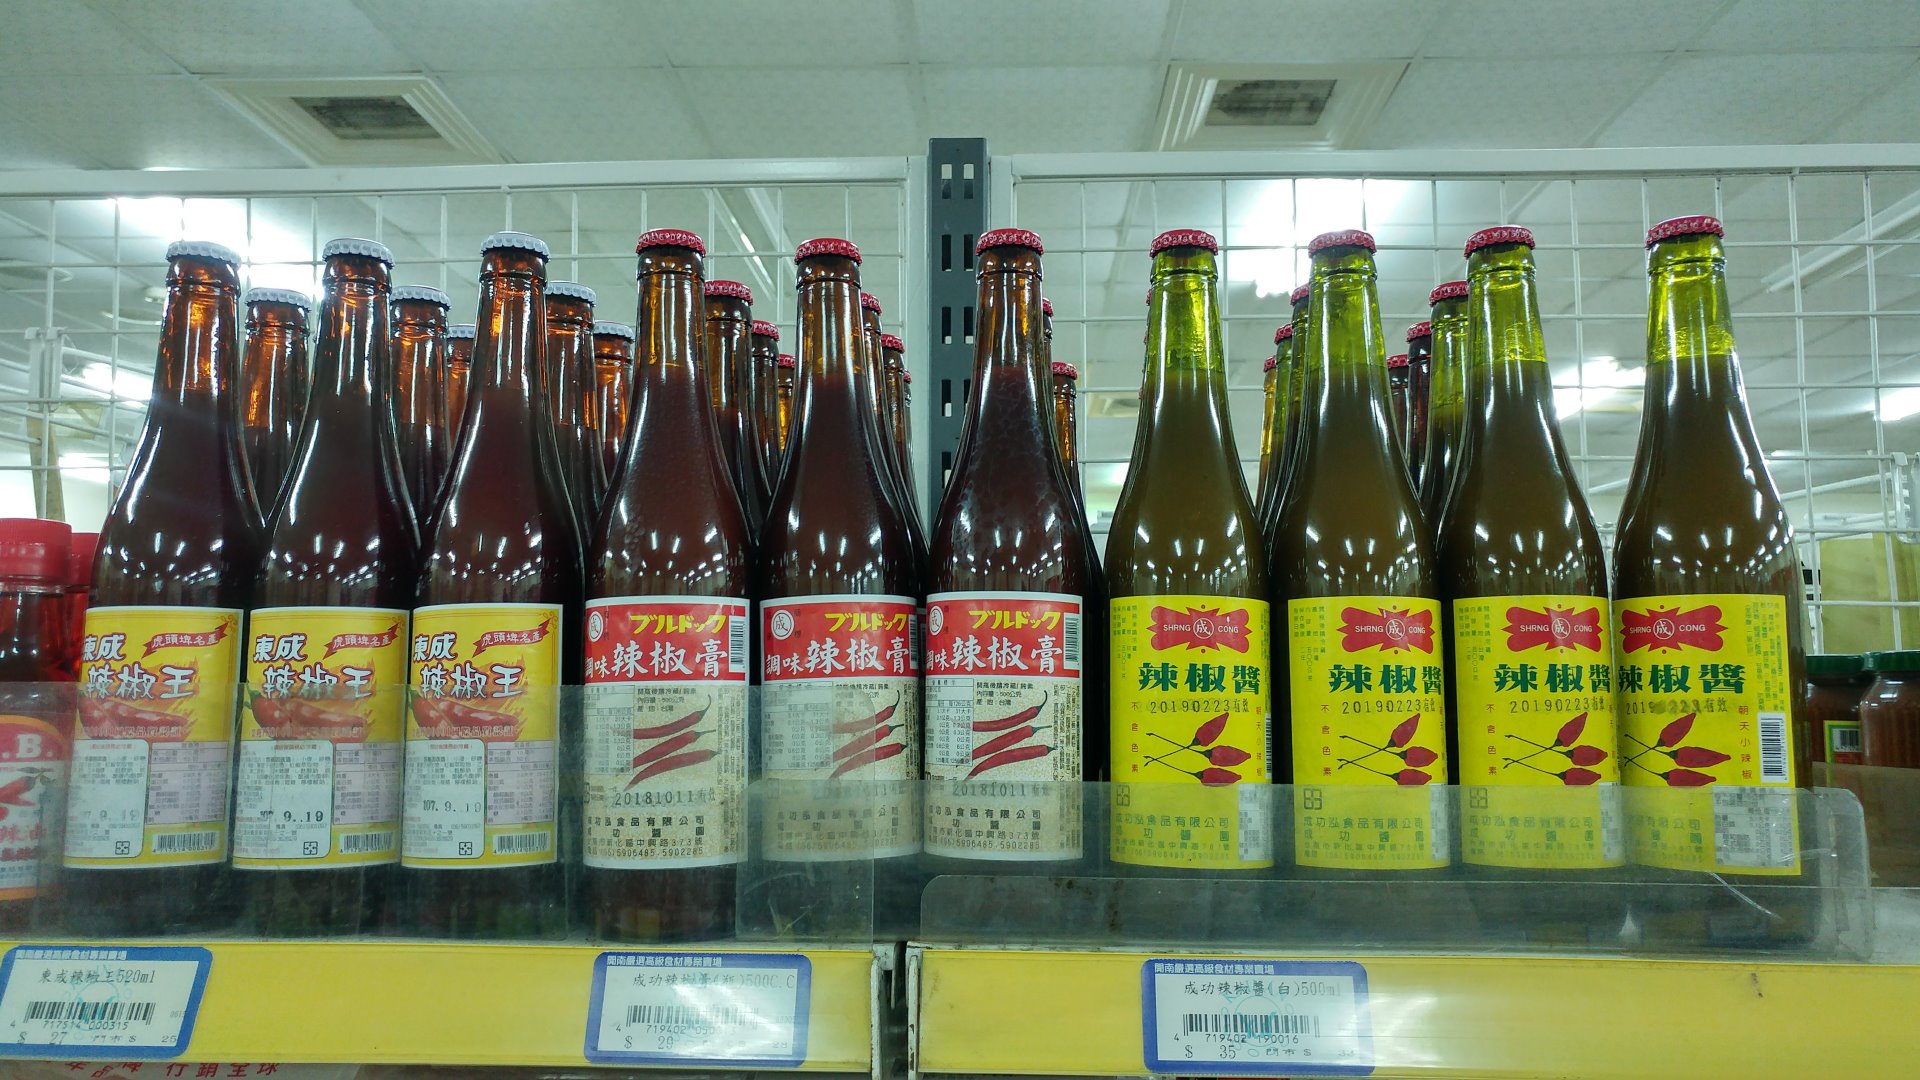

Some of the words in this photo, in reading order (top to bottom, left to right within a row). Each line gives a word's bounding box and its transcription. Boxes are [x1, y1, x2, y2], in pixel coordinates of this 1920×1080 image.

[630, 614, 727, 635] ブルドック
[824, 613, 907, 632] ブルドック
[968, 610, 1061, 630] ブルドック
[1218, 626, 1238, 634] CONG
[1408, 626, 1426, 634] CONG
[1679, 624, 1706, 632] CONG
[82, 634, 127, 661] 東成
[254, 633, 308, 662] 東成
[413, 631, 458, 662] 東成
[87, 663, 196, 698] 辣椒王
[263, 662, 373, 699] 辣椒王
[420, 660, 524, 699] 辣椒王
[1138, 662, 1261, 695] 辣椒醬
[1328, 664, 1441, 695] 辣椒醬
[1494, 664, 1610, 693] 辣椒醬
[1618, 663, 1746, 694] 辣椒醬
[44, 1020, 81, 1029] 717514
[89, 1020, 128, 1030] 000315
[646, 1025, 686, 1034] 719402
[1206, 1034, 1247, 1043] 719402
[1257, 1034, 1299, 1044] 190016
[1220, 1044, 1236, 1060] 35
